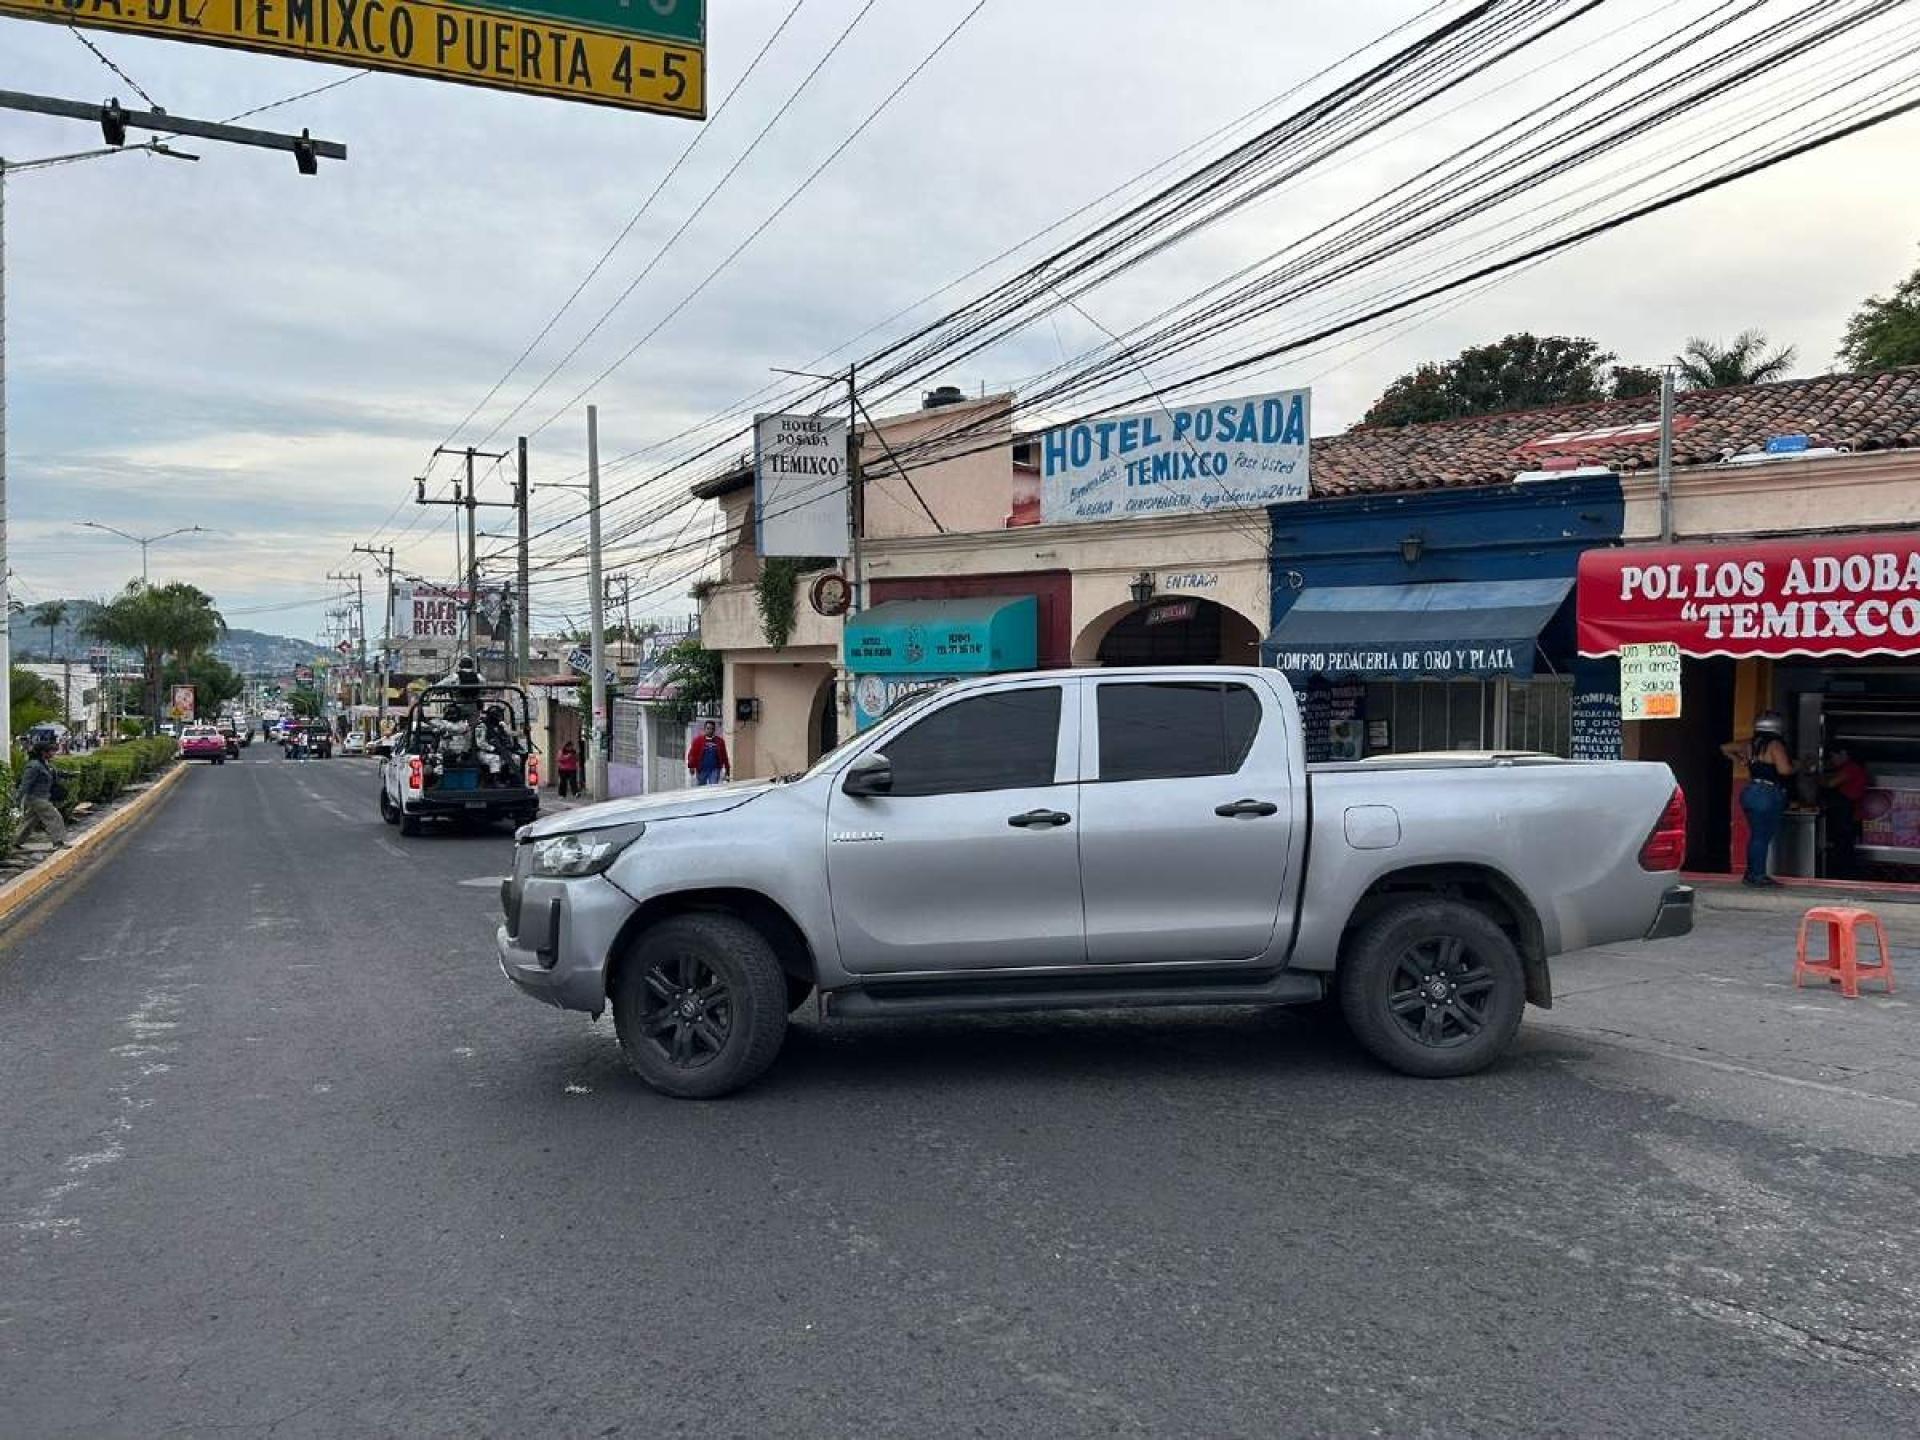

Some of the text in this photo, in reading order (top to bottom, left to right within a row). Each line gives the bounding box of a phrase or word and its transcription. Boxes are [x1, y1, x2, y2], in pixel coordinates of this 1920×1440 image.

[234, 0, 414, 59] TEMIXCO
[437, 14, 592, 87] PUERTA
[612, 45, 687, 101] 4-5
[782, 420, 822, 432] HOTEL
[1045, 394, 1305, 476] HOTEL POSADA
[777, 433, 829, 446] POSADA
[1124, 452, 1228, 487] TEMIXCO
[1620, 561, 1766, 600] POLLOS
[414, 601, 456, 619] RAFA
[414, 620, 456, 635] REYES
[1276, 648, 1515, 671] COMPRO PEDACERIA DE ORO Y PLATA
